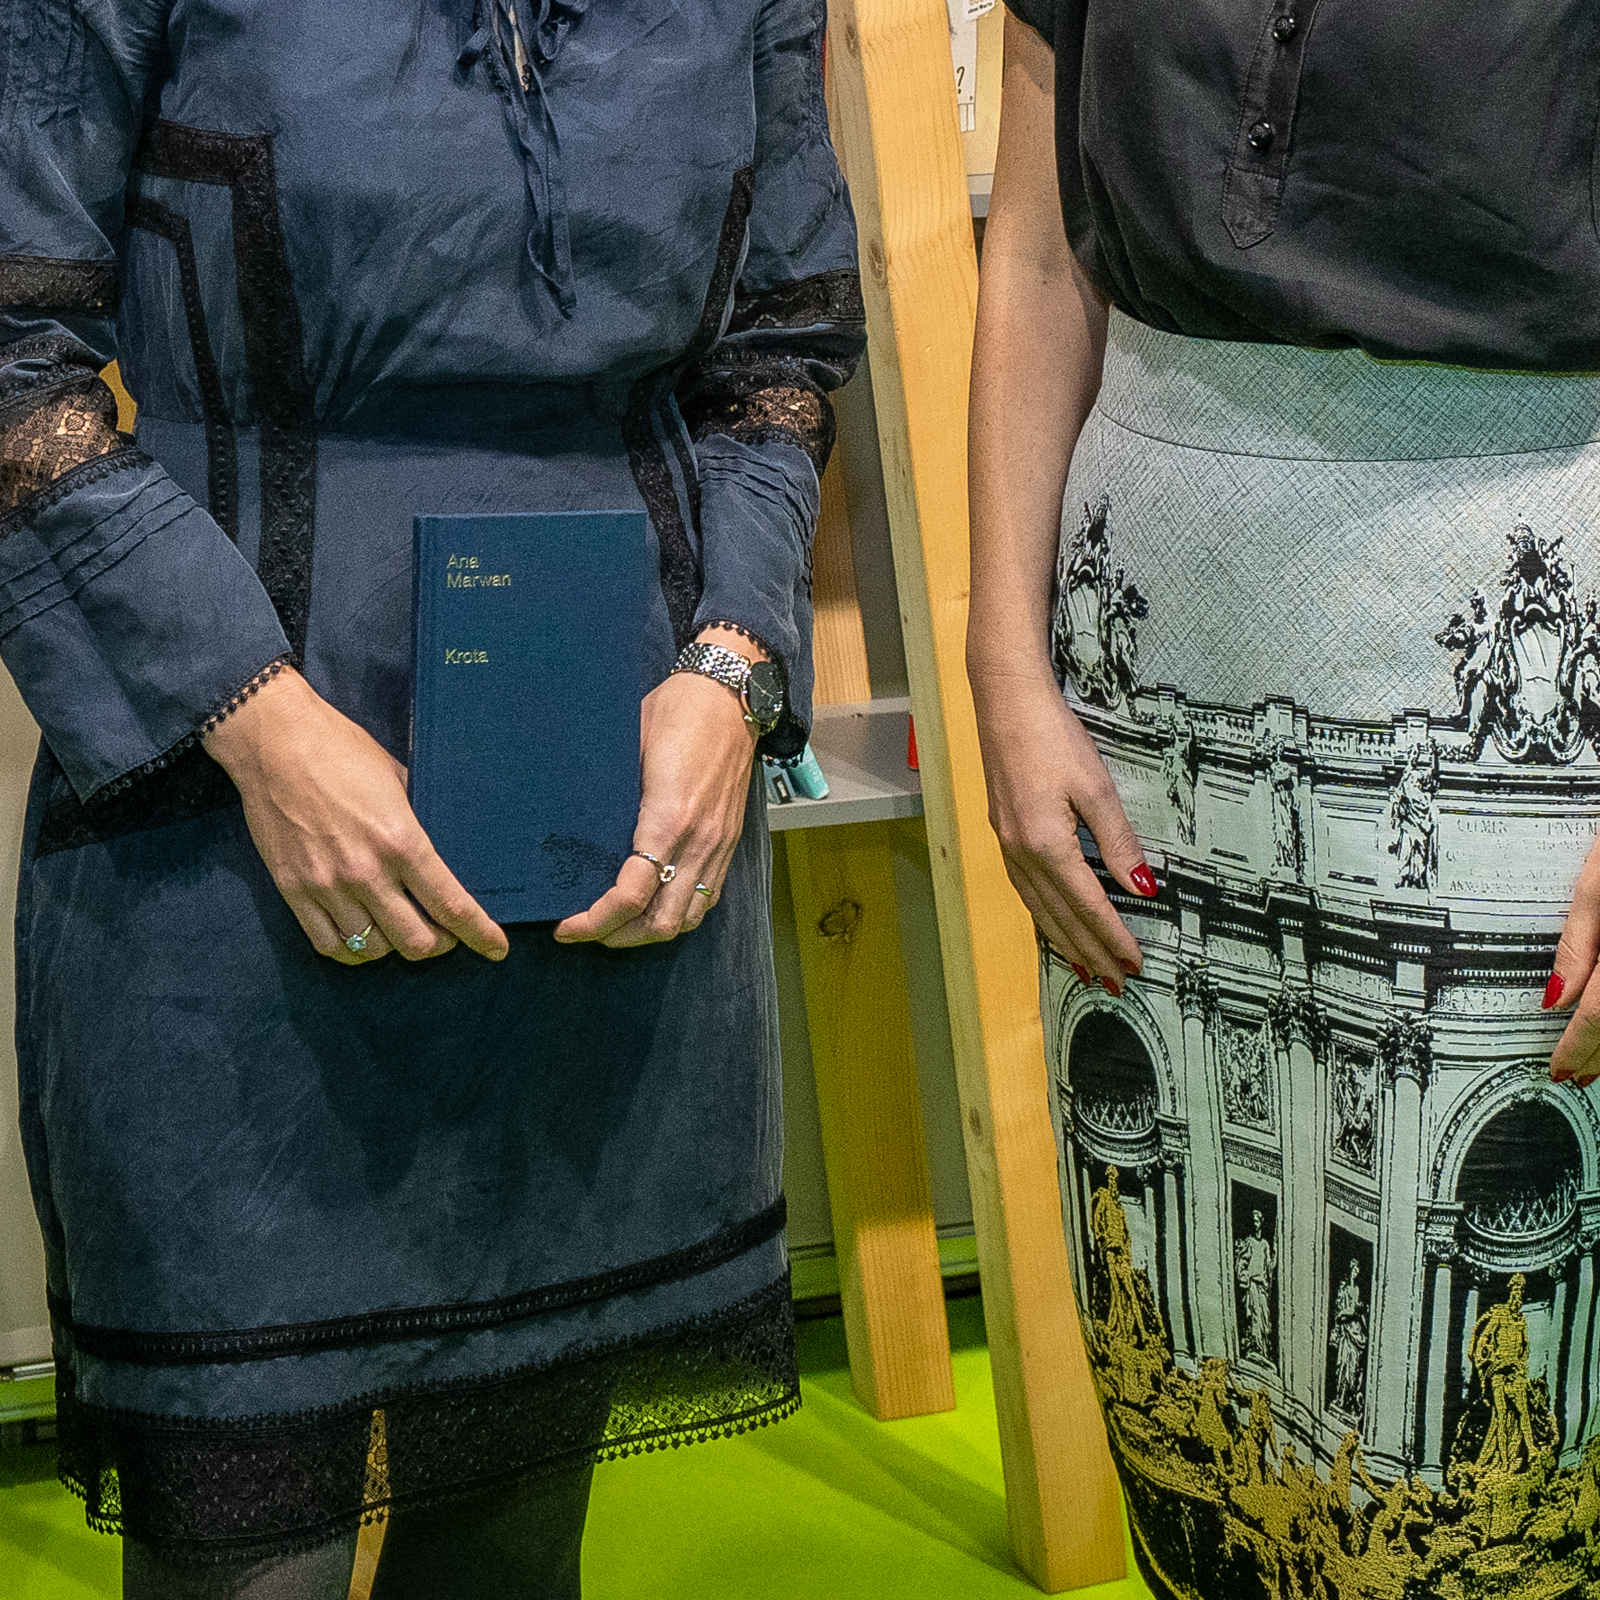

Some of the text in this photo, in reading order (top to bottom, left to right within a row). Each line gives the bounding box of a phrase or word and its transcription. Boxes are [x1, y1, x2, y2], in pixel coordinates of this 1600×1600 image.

[446, 553, 479, 569] Ana
[446, 572, 512, 588] Marwan
[445, 649, 489, 665] Krota
